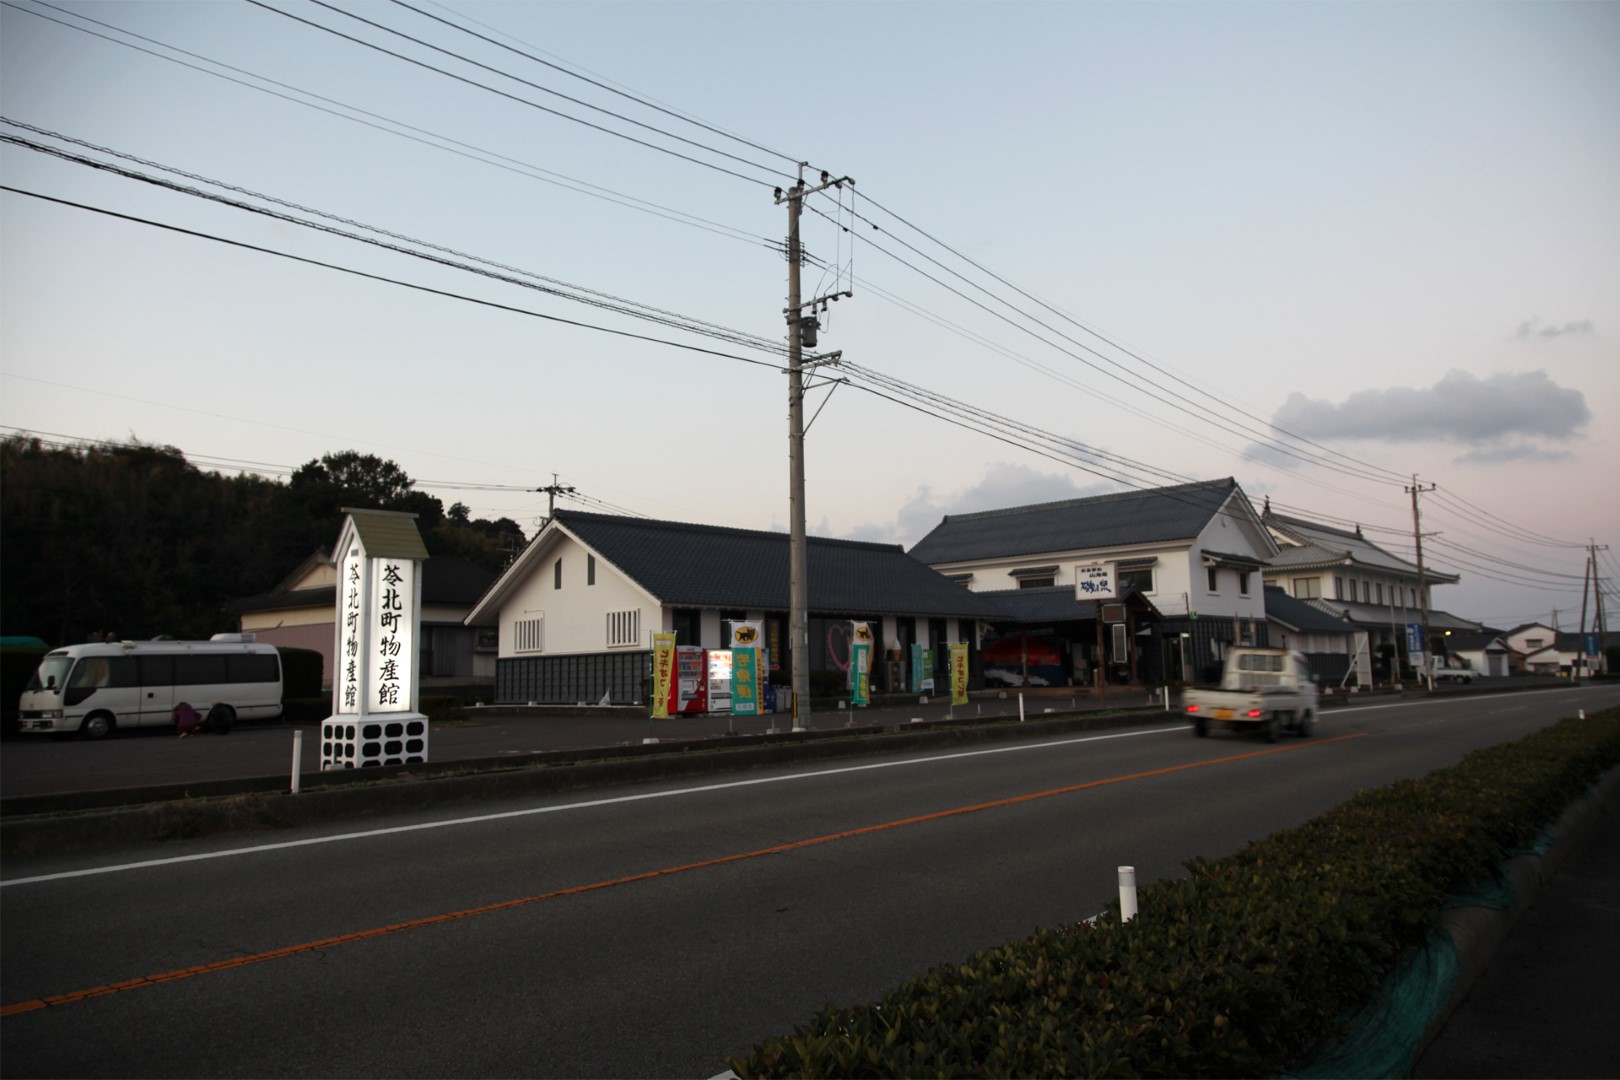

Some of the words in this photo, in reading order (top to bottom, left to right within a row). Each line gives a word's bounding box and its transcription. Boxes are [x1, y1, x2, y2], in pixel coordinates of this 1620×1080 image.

[345, 563, 360, 707] 苓北町物産館
[378, 564, 404, 706] 苓北町物産館
